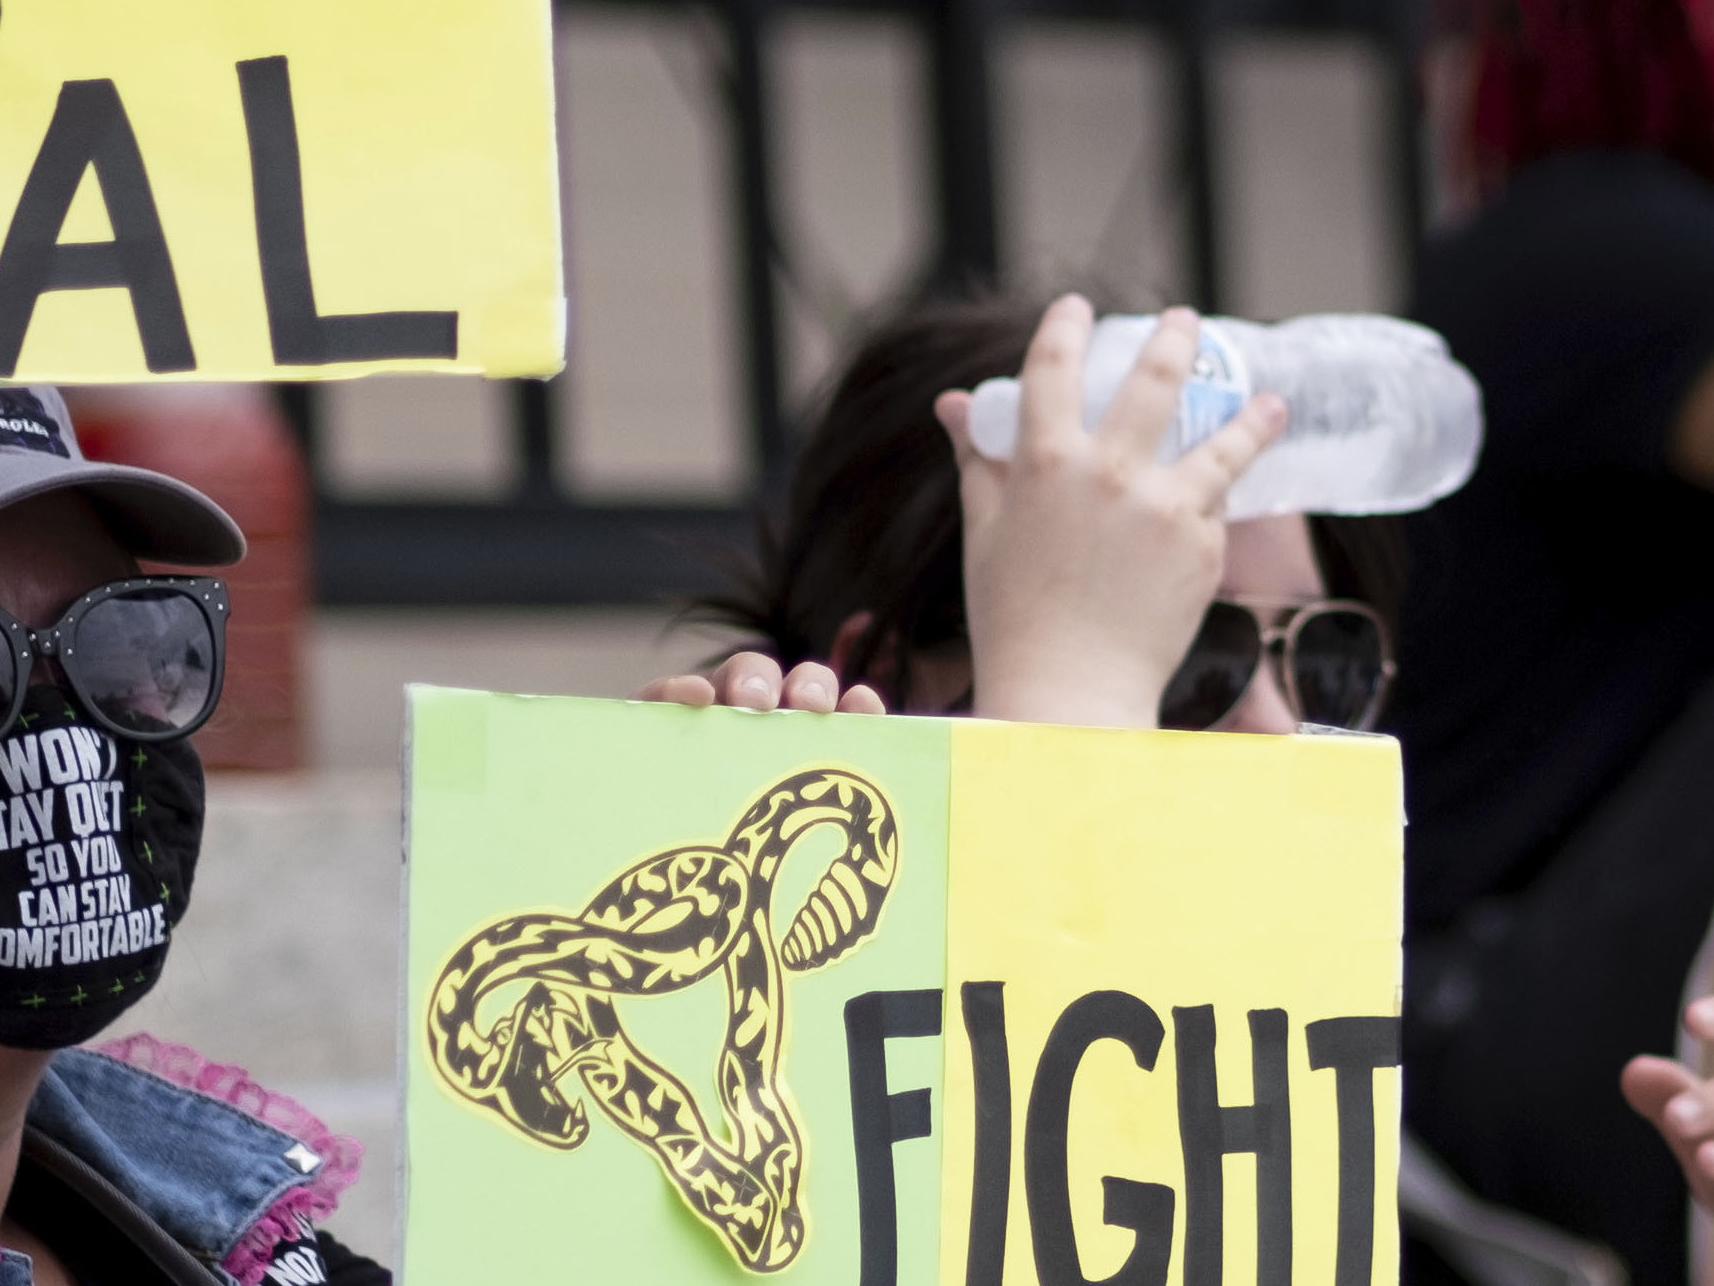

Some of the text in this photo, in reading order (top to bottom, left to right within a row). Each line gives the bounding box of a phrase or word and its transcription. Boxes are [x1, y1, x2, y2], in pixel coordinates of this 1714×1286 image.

[65, 780, 124, 838] QUET
[26, 835, 122, 886] SO YOU
[18, 874, 131, 927] CAN STAY
